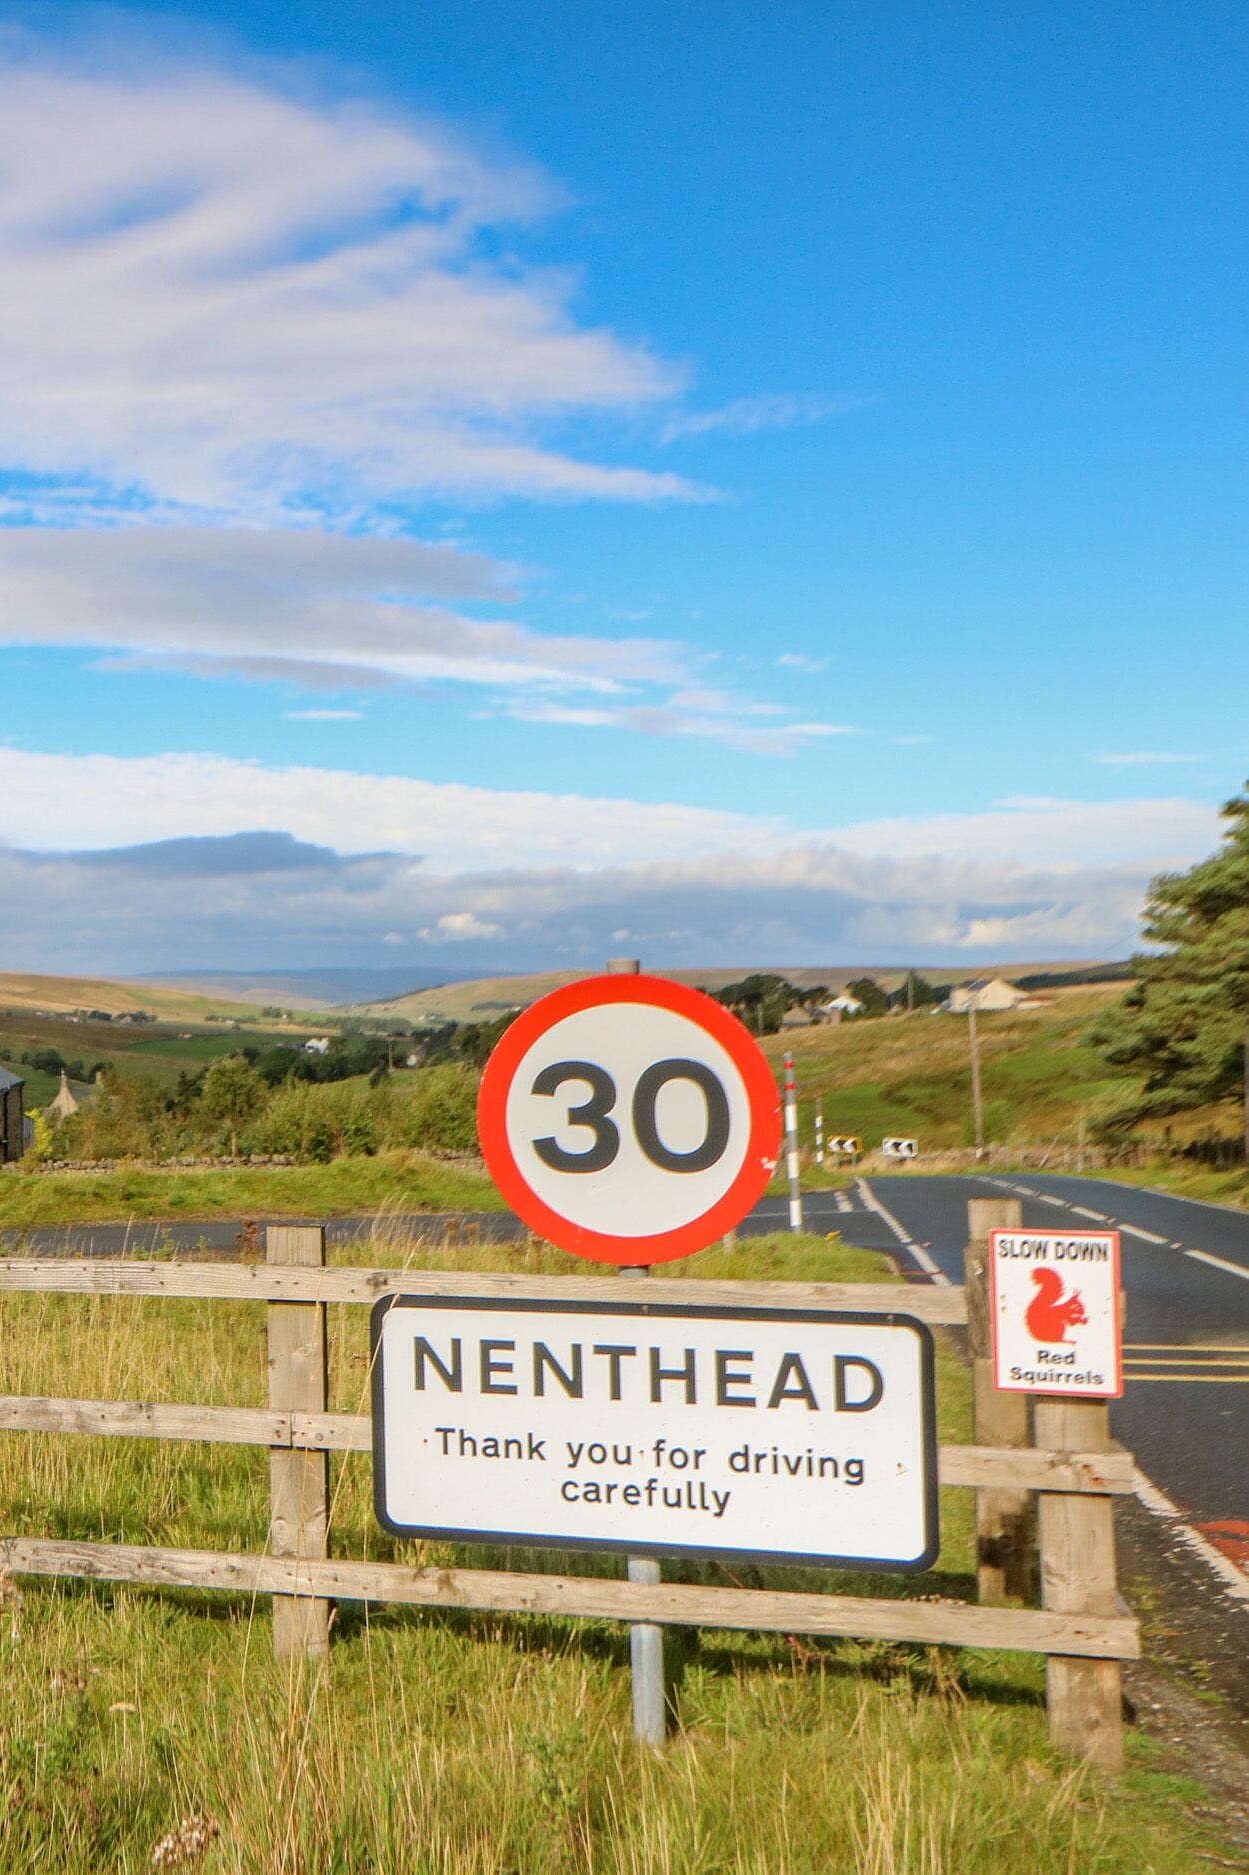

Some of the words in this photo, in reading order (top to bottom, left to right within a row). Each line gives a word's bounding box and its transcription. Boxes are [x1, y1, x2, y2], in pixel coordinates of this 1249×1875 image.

[530, 1058, 731, 1174] 30
[998, 1239, 1049, 1260] SLOW
[1055, 1241, 1109, 1262] DOWN
[413, 1336, 885, 1413] NENTHEAD
[1009, 1366, 1104, 1385] Squirrels
[1037, 1350, 1076, 1365] Red
[435, 1427, 546, 1461] Thank
[566, 1441, 632, 1469] you
[652, 1439, 706, 1470] for
[729, 1445, 866, 1486] driving
[561, 1479, 731, 1518] carefully
